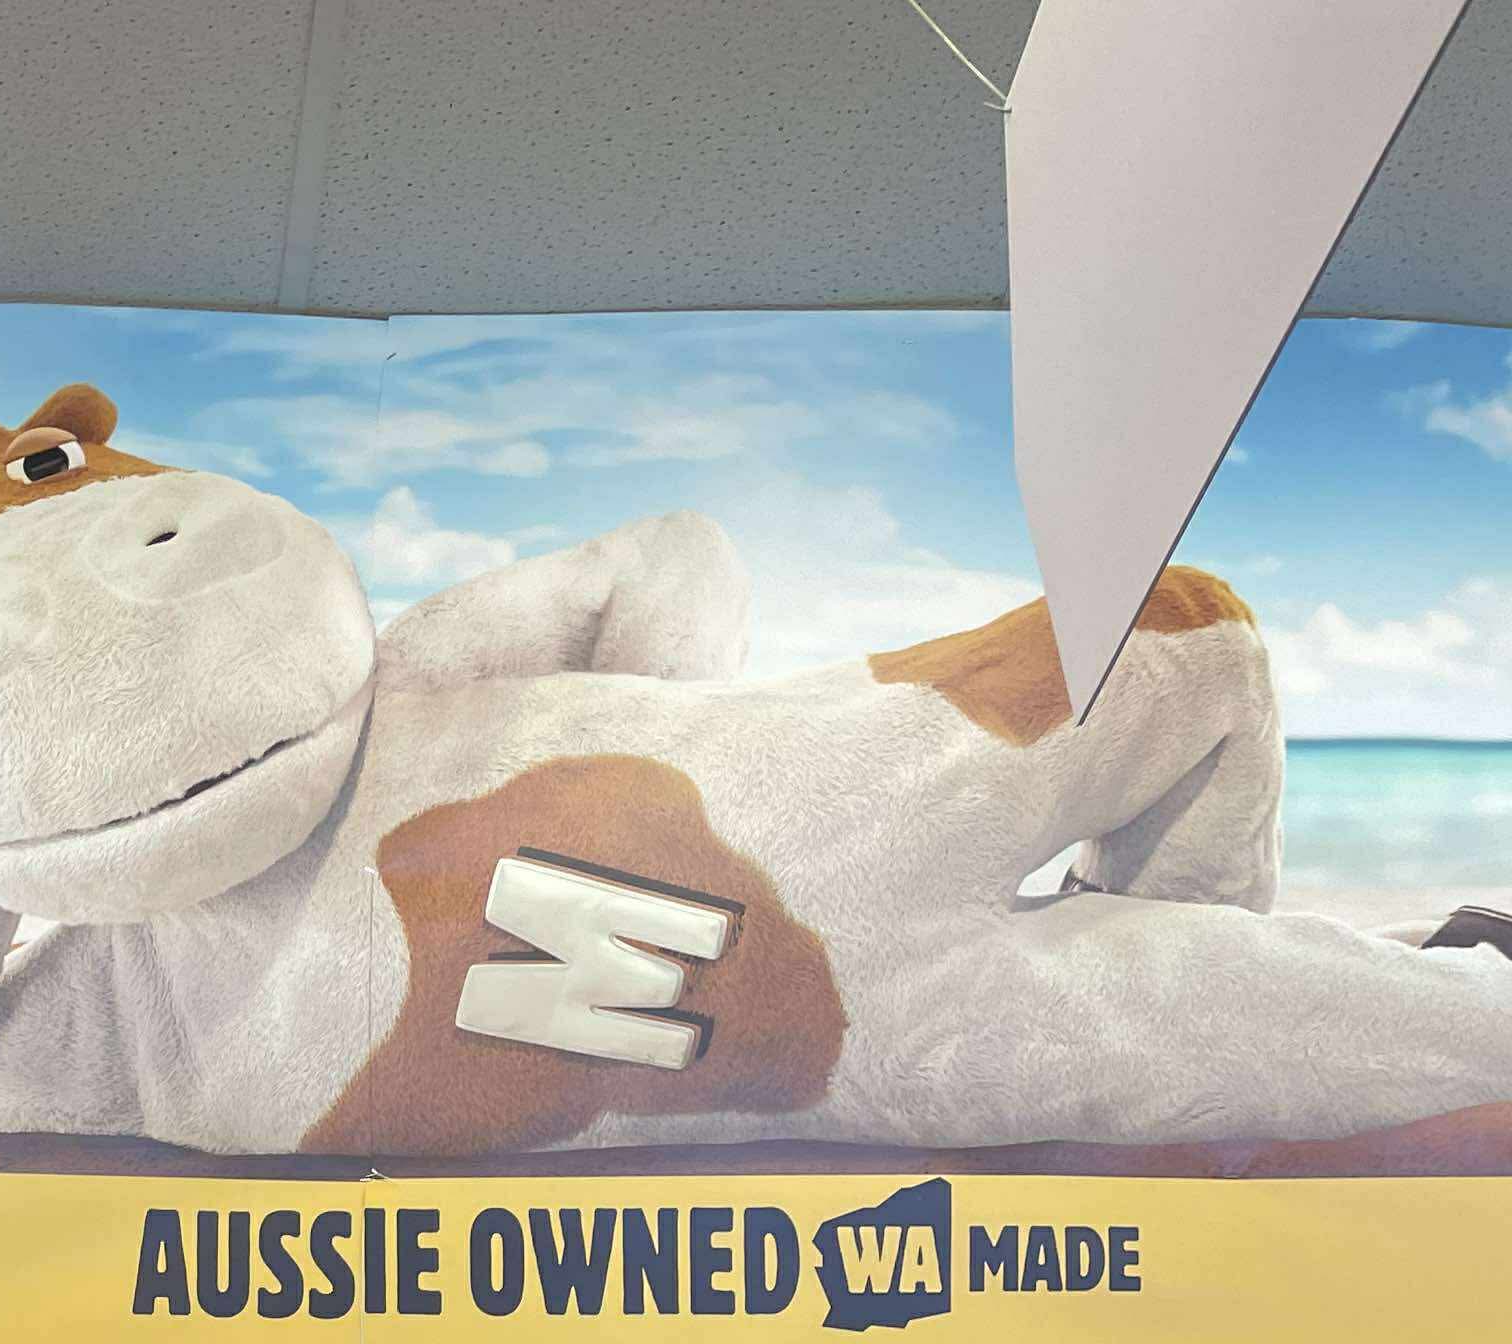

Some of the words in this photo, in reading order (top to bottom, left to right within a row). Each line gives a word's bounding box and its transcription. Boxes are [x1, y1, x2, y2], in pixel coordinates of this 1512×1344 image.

[455, 857, 730, 1071] M
[132, 1208, 443, 1319] AUSSIE
[469, 1207, 801, 1316] OWNED
[837, 1225, 943, 1294] WA
[969, 1225, 1141, 1293] MADE
